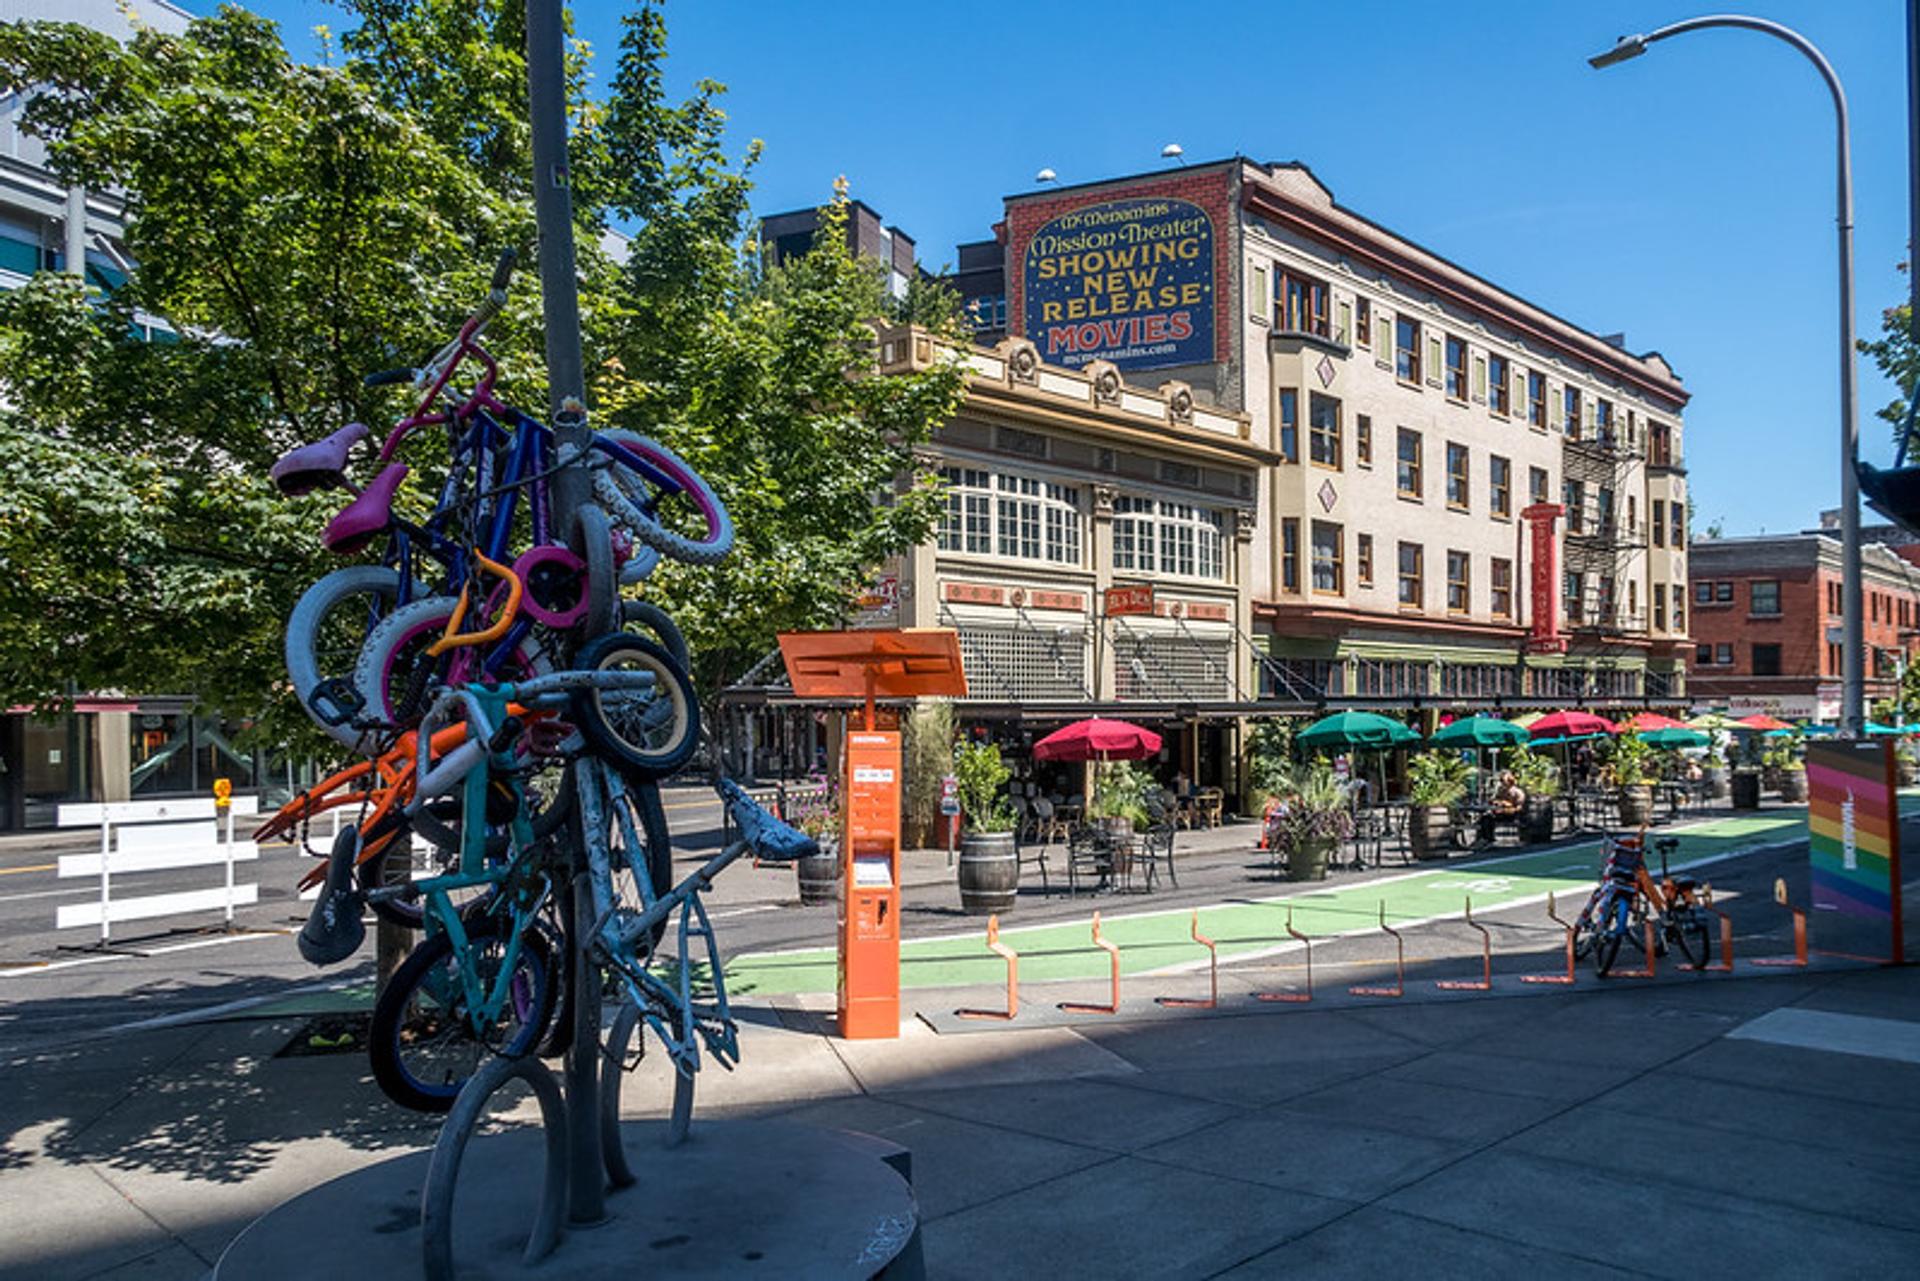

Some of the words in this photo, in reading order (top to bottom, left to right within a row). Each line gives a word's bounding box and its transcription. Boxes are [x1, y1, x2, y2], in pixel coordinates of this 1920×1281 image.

[1031, 231, 1116, 257] Mission
[1118, 216, 1206, 244] Theater
[1037, 238, 1200, 279] SHOWING
[1083, 266, 1159, 296] NEW
[1042, 283, 1201, 323] RELEASE
[1047, 311, 1193, 355] MOVIES
